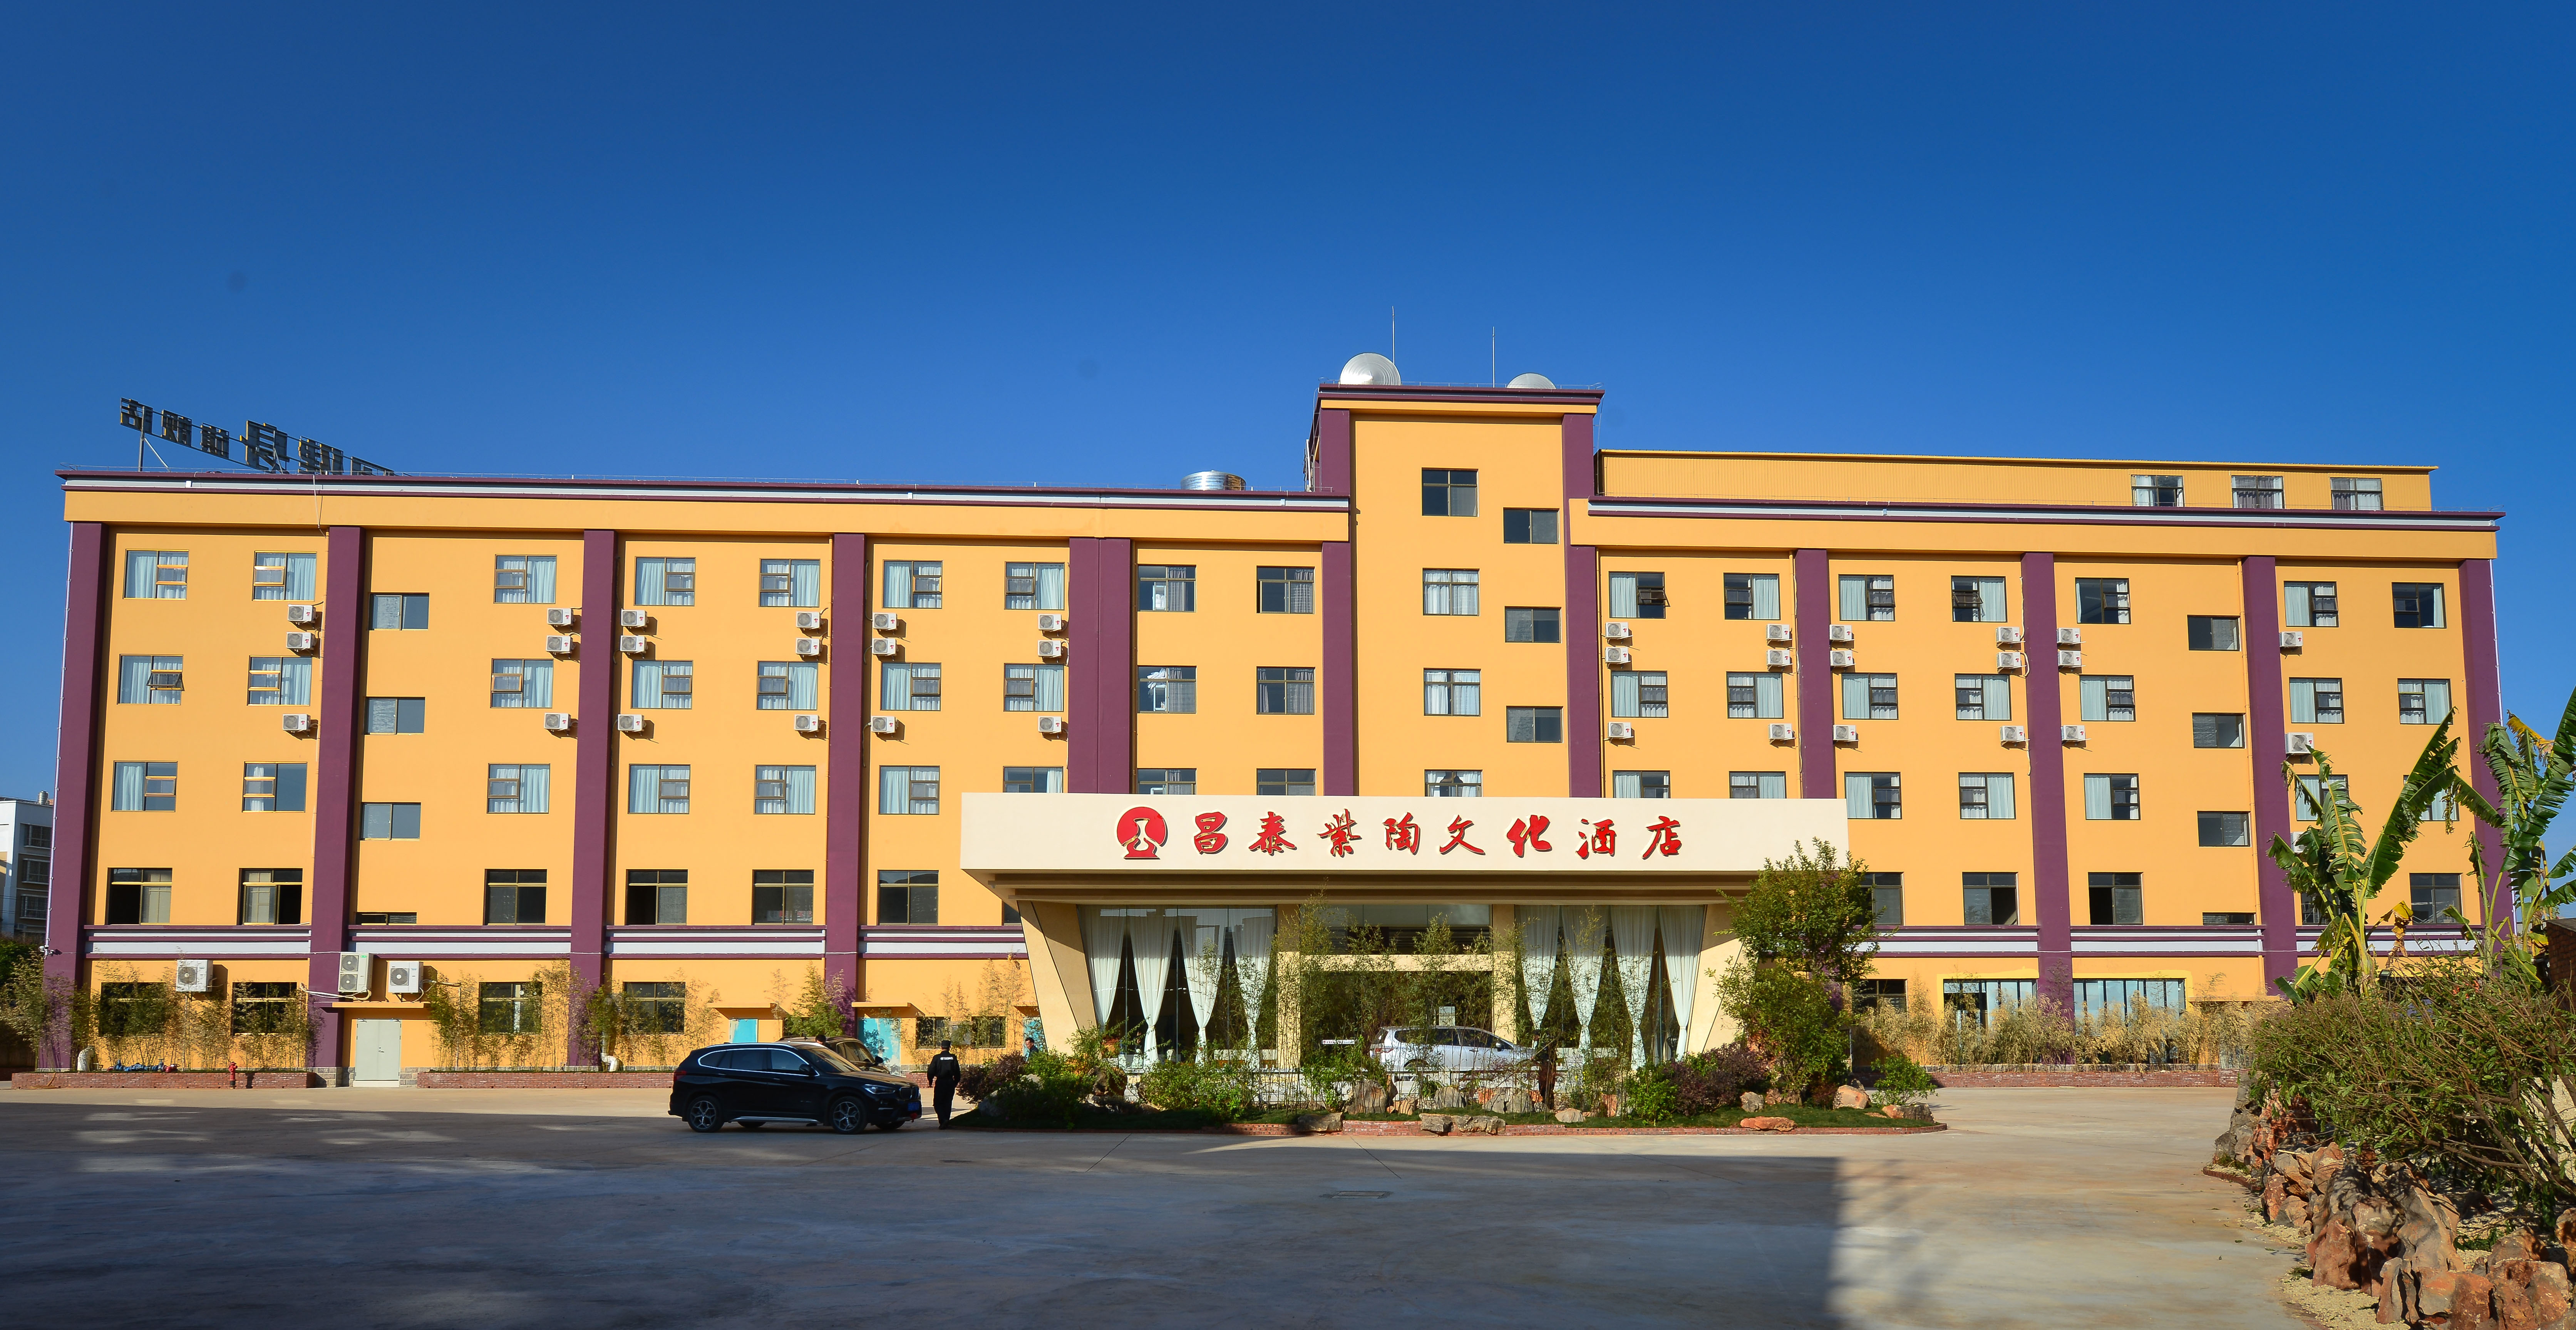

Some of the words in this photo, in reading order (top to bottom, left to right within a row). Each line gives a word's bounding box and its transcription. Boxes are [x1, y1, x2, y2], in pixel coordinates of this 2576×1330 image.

[1193, 809, 1682, 859] 昌泰紫陶文化酒店
